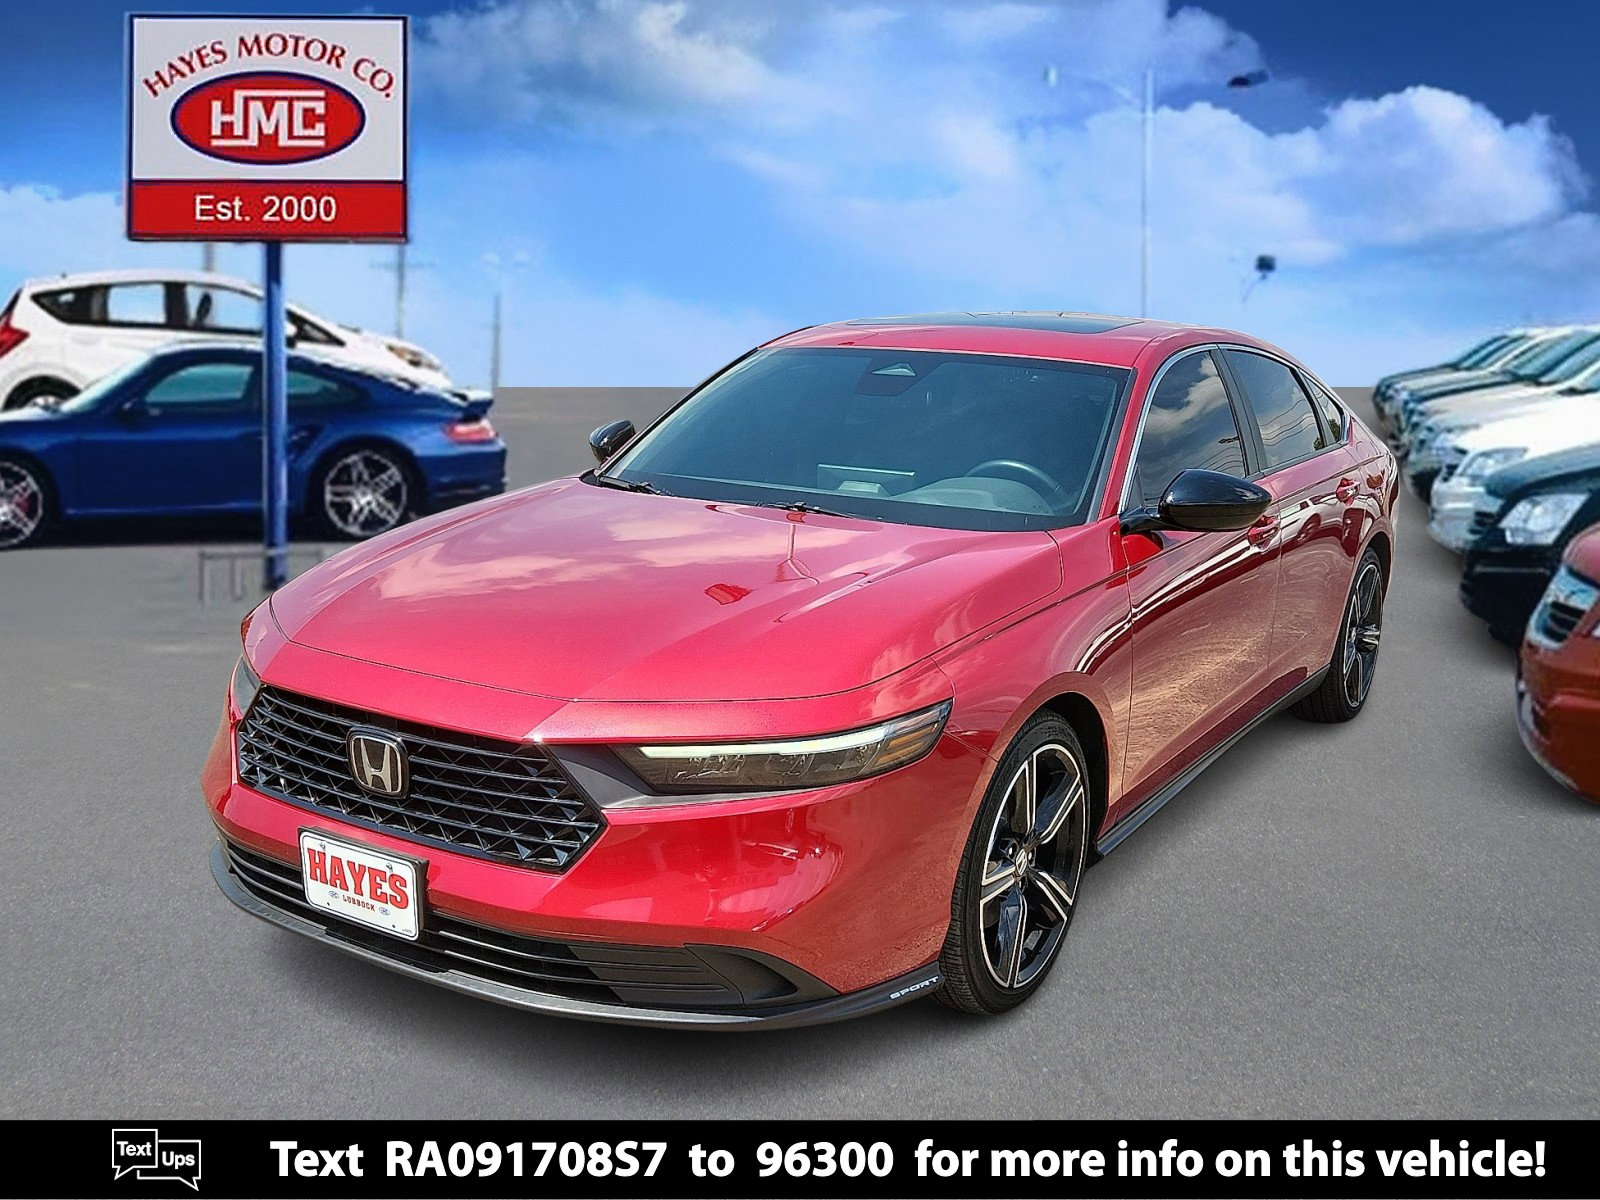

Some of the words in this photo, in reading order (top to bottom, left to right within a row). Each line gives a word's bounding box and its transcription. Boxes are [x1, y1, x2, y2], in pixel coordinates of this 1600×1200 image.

[142, 40, 228, 98] HAYES
[237, 32, 347, 70] MOTOR
[352, 57, 395, 99] CO.
[210, 88, 327, 148] HMC
[194, 194, 251, 222] Est.
[262, 195, 337, 222] 2000
[307, 848, 409, 909] HAYES
[889, 975, 939, 1000] SPORT
